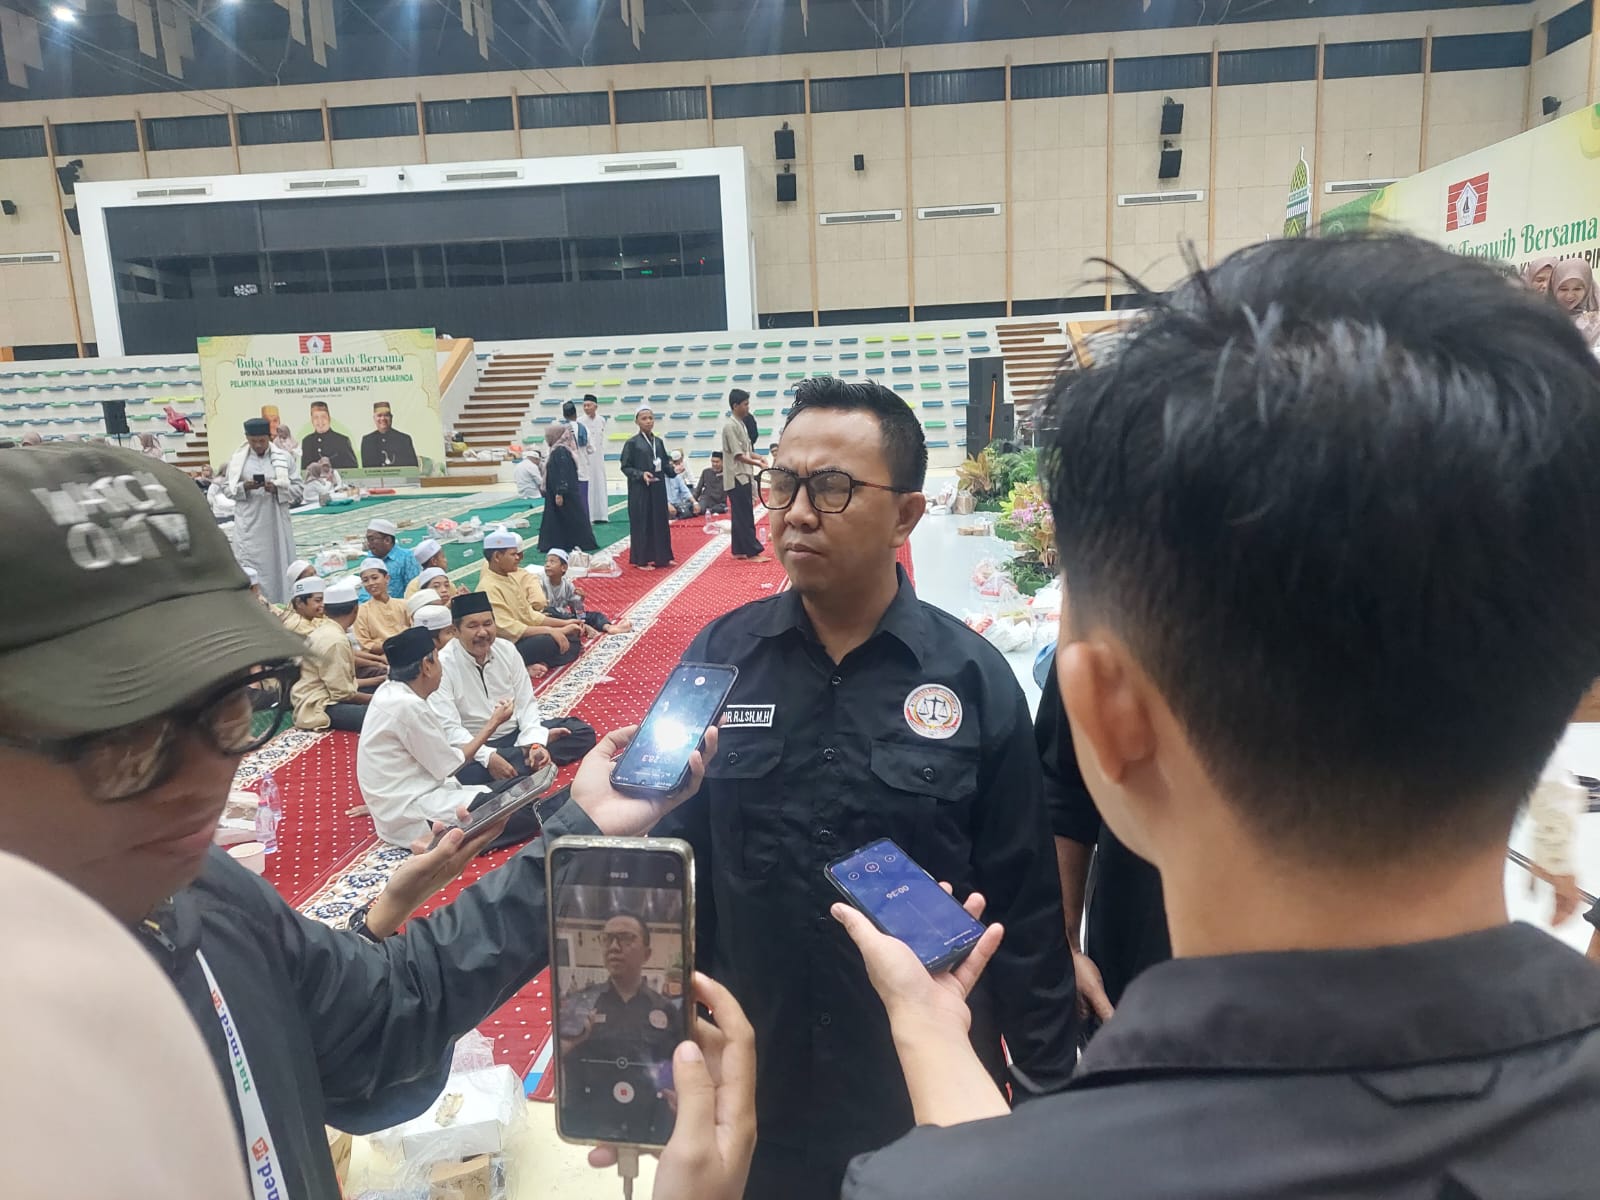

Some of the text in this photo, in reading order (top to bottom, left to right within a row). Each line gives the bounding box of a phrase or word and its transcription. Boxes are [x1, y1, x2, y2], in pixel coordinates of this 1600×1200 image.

[1521, 216, 1598, 254] Bersama
[237, 353, 405, 370] Buka Puasa & Tarawih Bersama
[266, 368, 297, 376] SAMARINDA
[230, 380, 267, 388] PELANTIKAN
[296, 378, 318, 386] KALTIM
[319, 377, 331, 385] DAN
[346, 375, 361, 384] KKSS
[363, 375, 379, 383] KOTA
[380, 374, 414, 383] SAMARINDA
